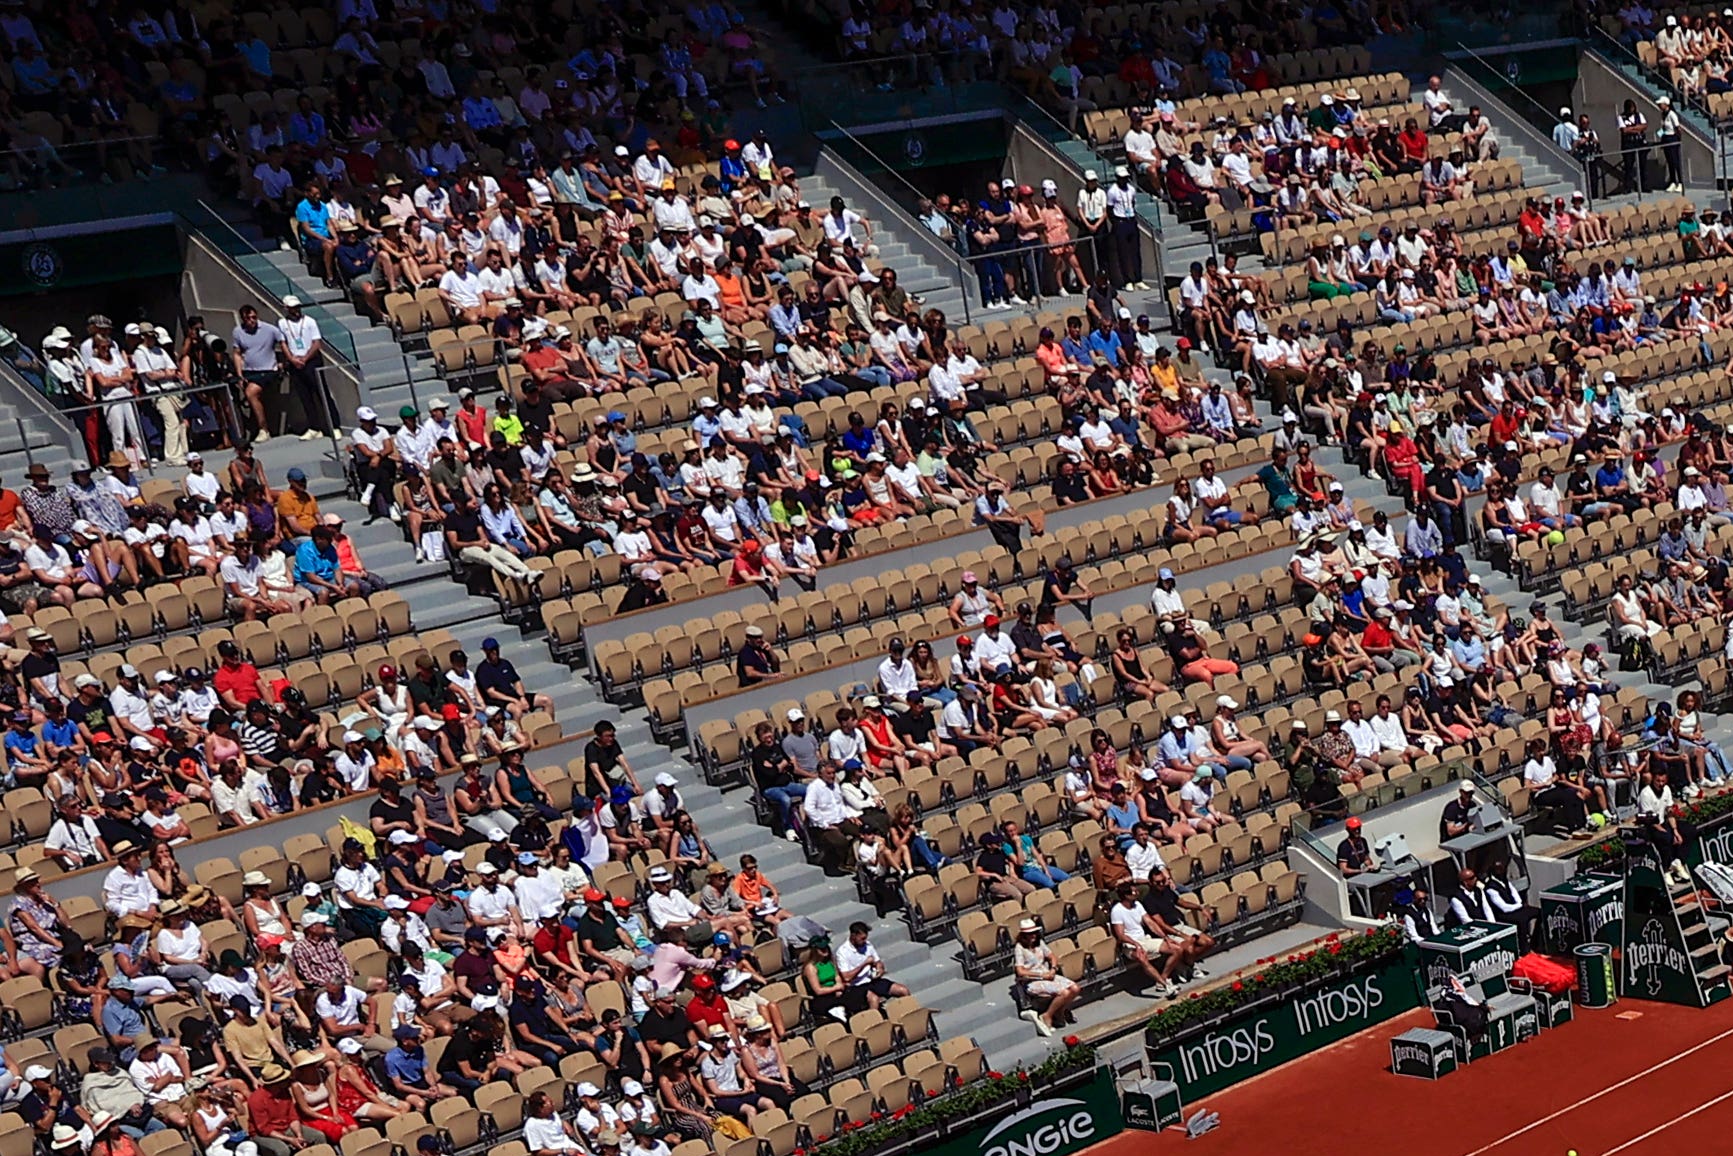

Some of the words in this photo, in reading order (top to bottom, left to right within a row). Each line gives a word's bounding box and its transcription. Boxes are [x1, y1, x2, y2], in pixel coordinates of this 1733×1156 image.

[1588, 895, 1623, 943] perrie
[1627, 942, 1686, 986] perrier
[1294, 974, 1383, 1036] Infosys
[1179, 1019, 1274, 1084] Infosys
[1394, 1044, 1430, 1071] perrier
[1127, 1116, 1155, 1127] LACOSTE
